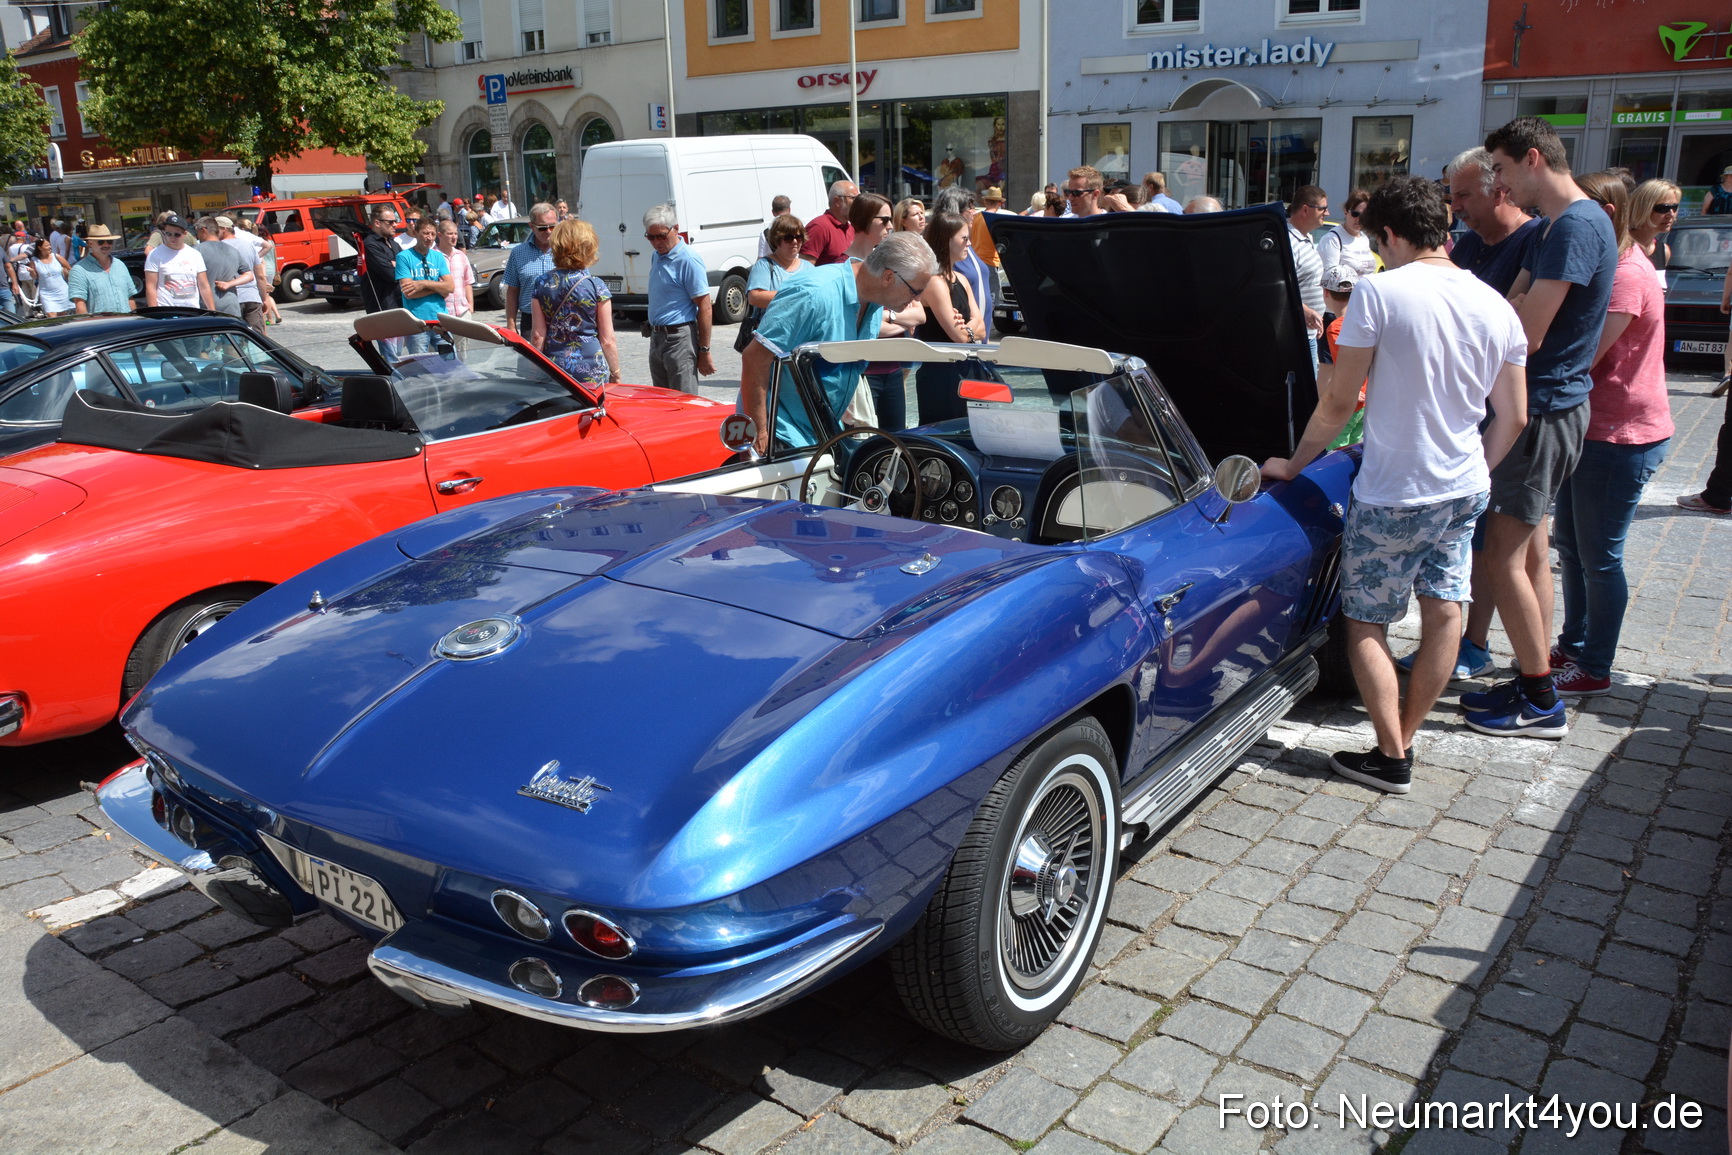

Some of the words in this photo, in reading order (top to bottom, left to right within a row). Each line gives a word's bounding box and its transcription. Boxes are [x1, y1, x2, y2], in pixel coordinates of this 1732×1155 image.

[1146, 43, 1248, 70] mister
[1261, 36, 1335, 68] lady
[489, 78, 501, 101] P
[797, 69, 878, 96] orsay
[1617, 112, 1666, 123] GRAVIS
[1681, 342, 1693, 351] AN
[1698, 343, 1711, 352] GT
[318, 869, 344, 906] PI
